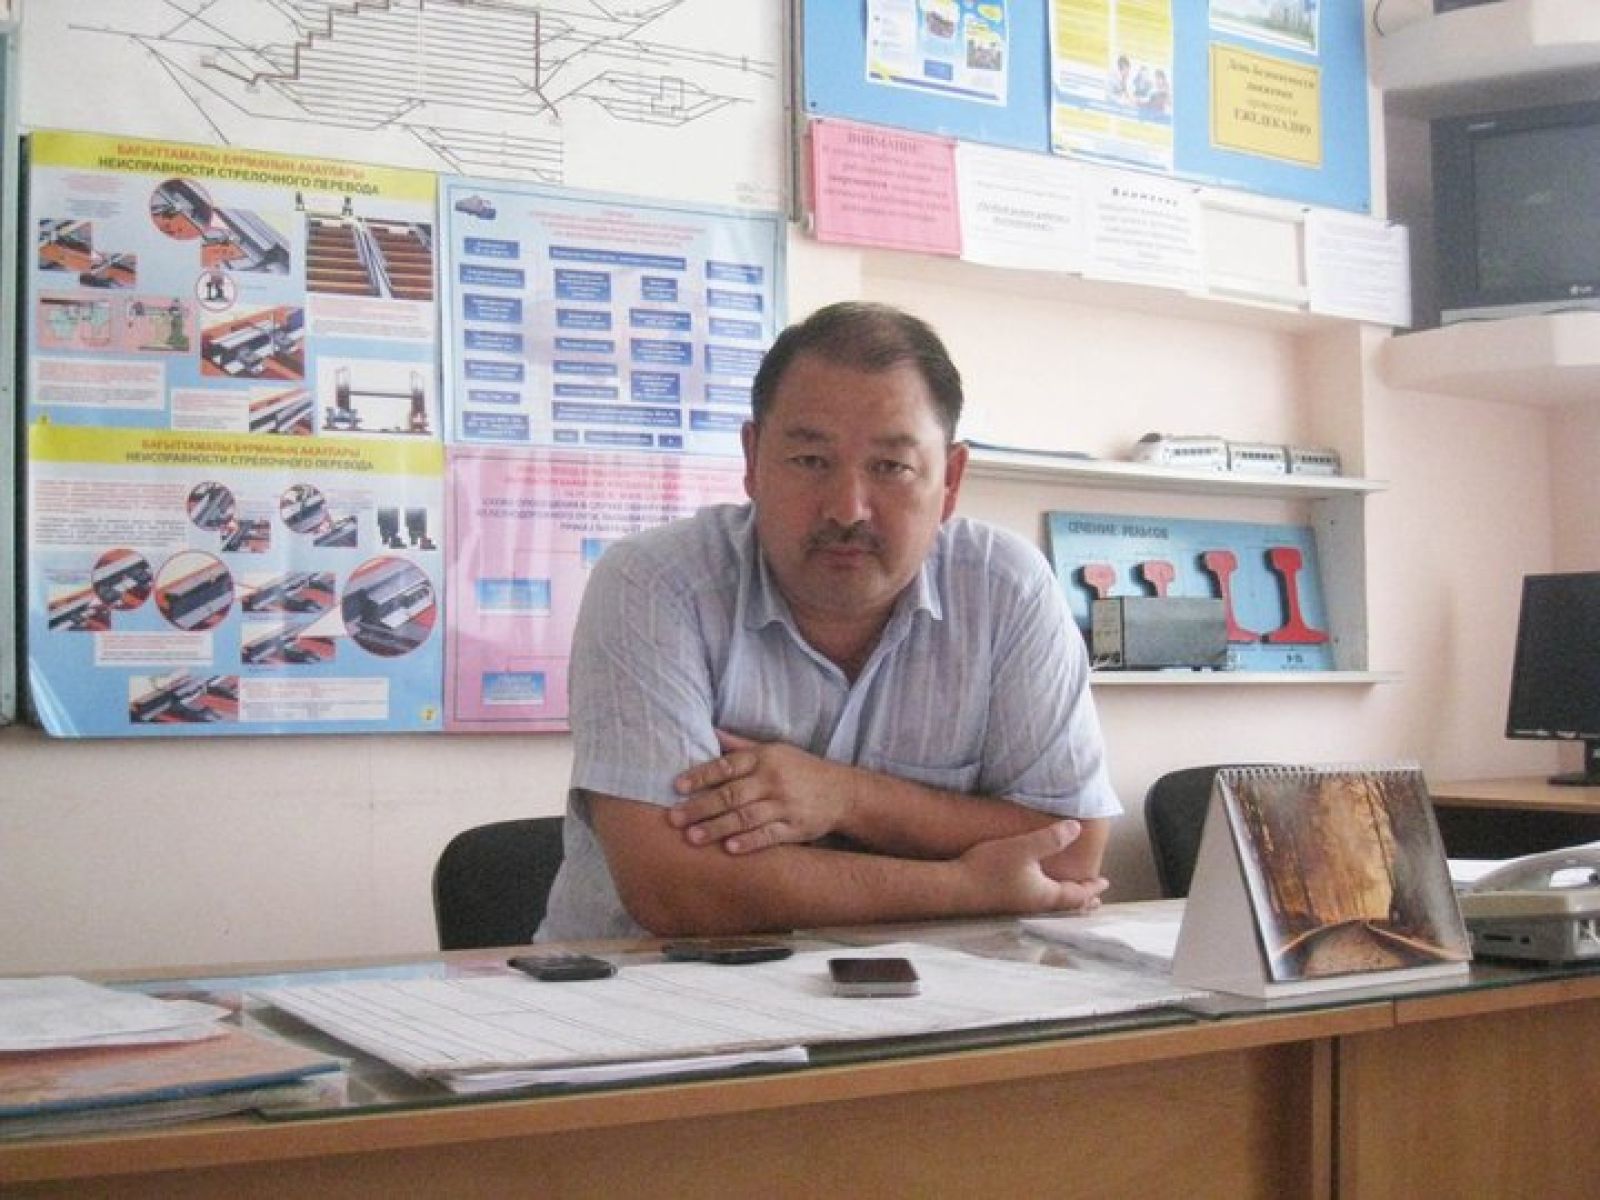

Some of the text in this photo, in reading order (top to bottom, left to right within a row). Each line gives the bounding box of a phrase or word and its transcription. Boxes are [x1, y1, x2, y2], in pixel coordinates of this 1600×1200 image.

[98, 156, 380, 196] НЕИСПРАВНОСТИ СТРЕЛОЧНОГО ПЕРЕВОДА
[126, 451, 228, 465] НЕИСПРАВНОСТИ
[230, 455, 312, 469] СТРЕЛОЧНОГО
